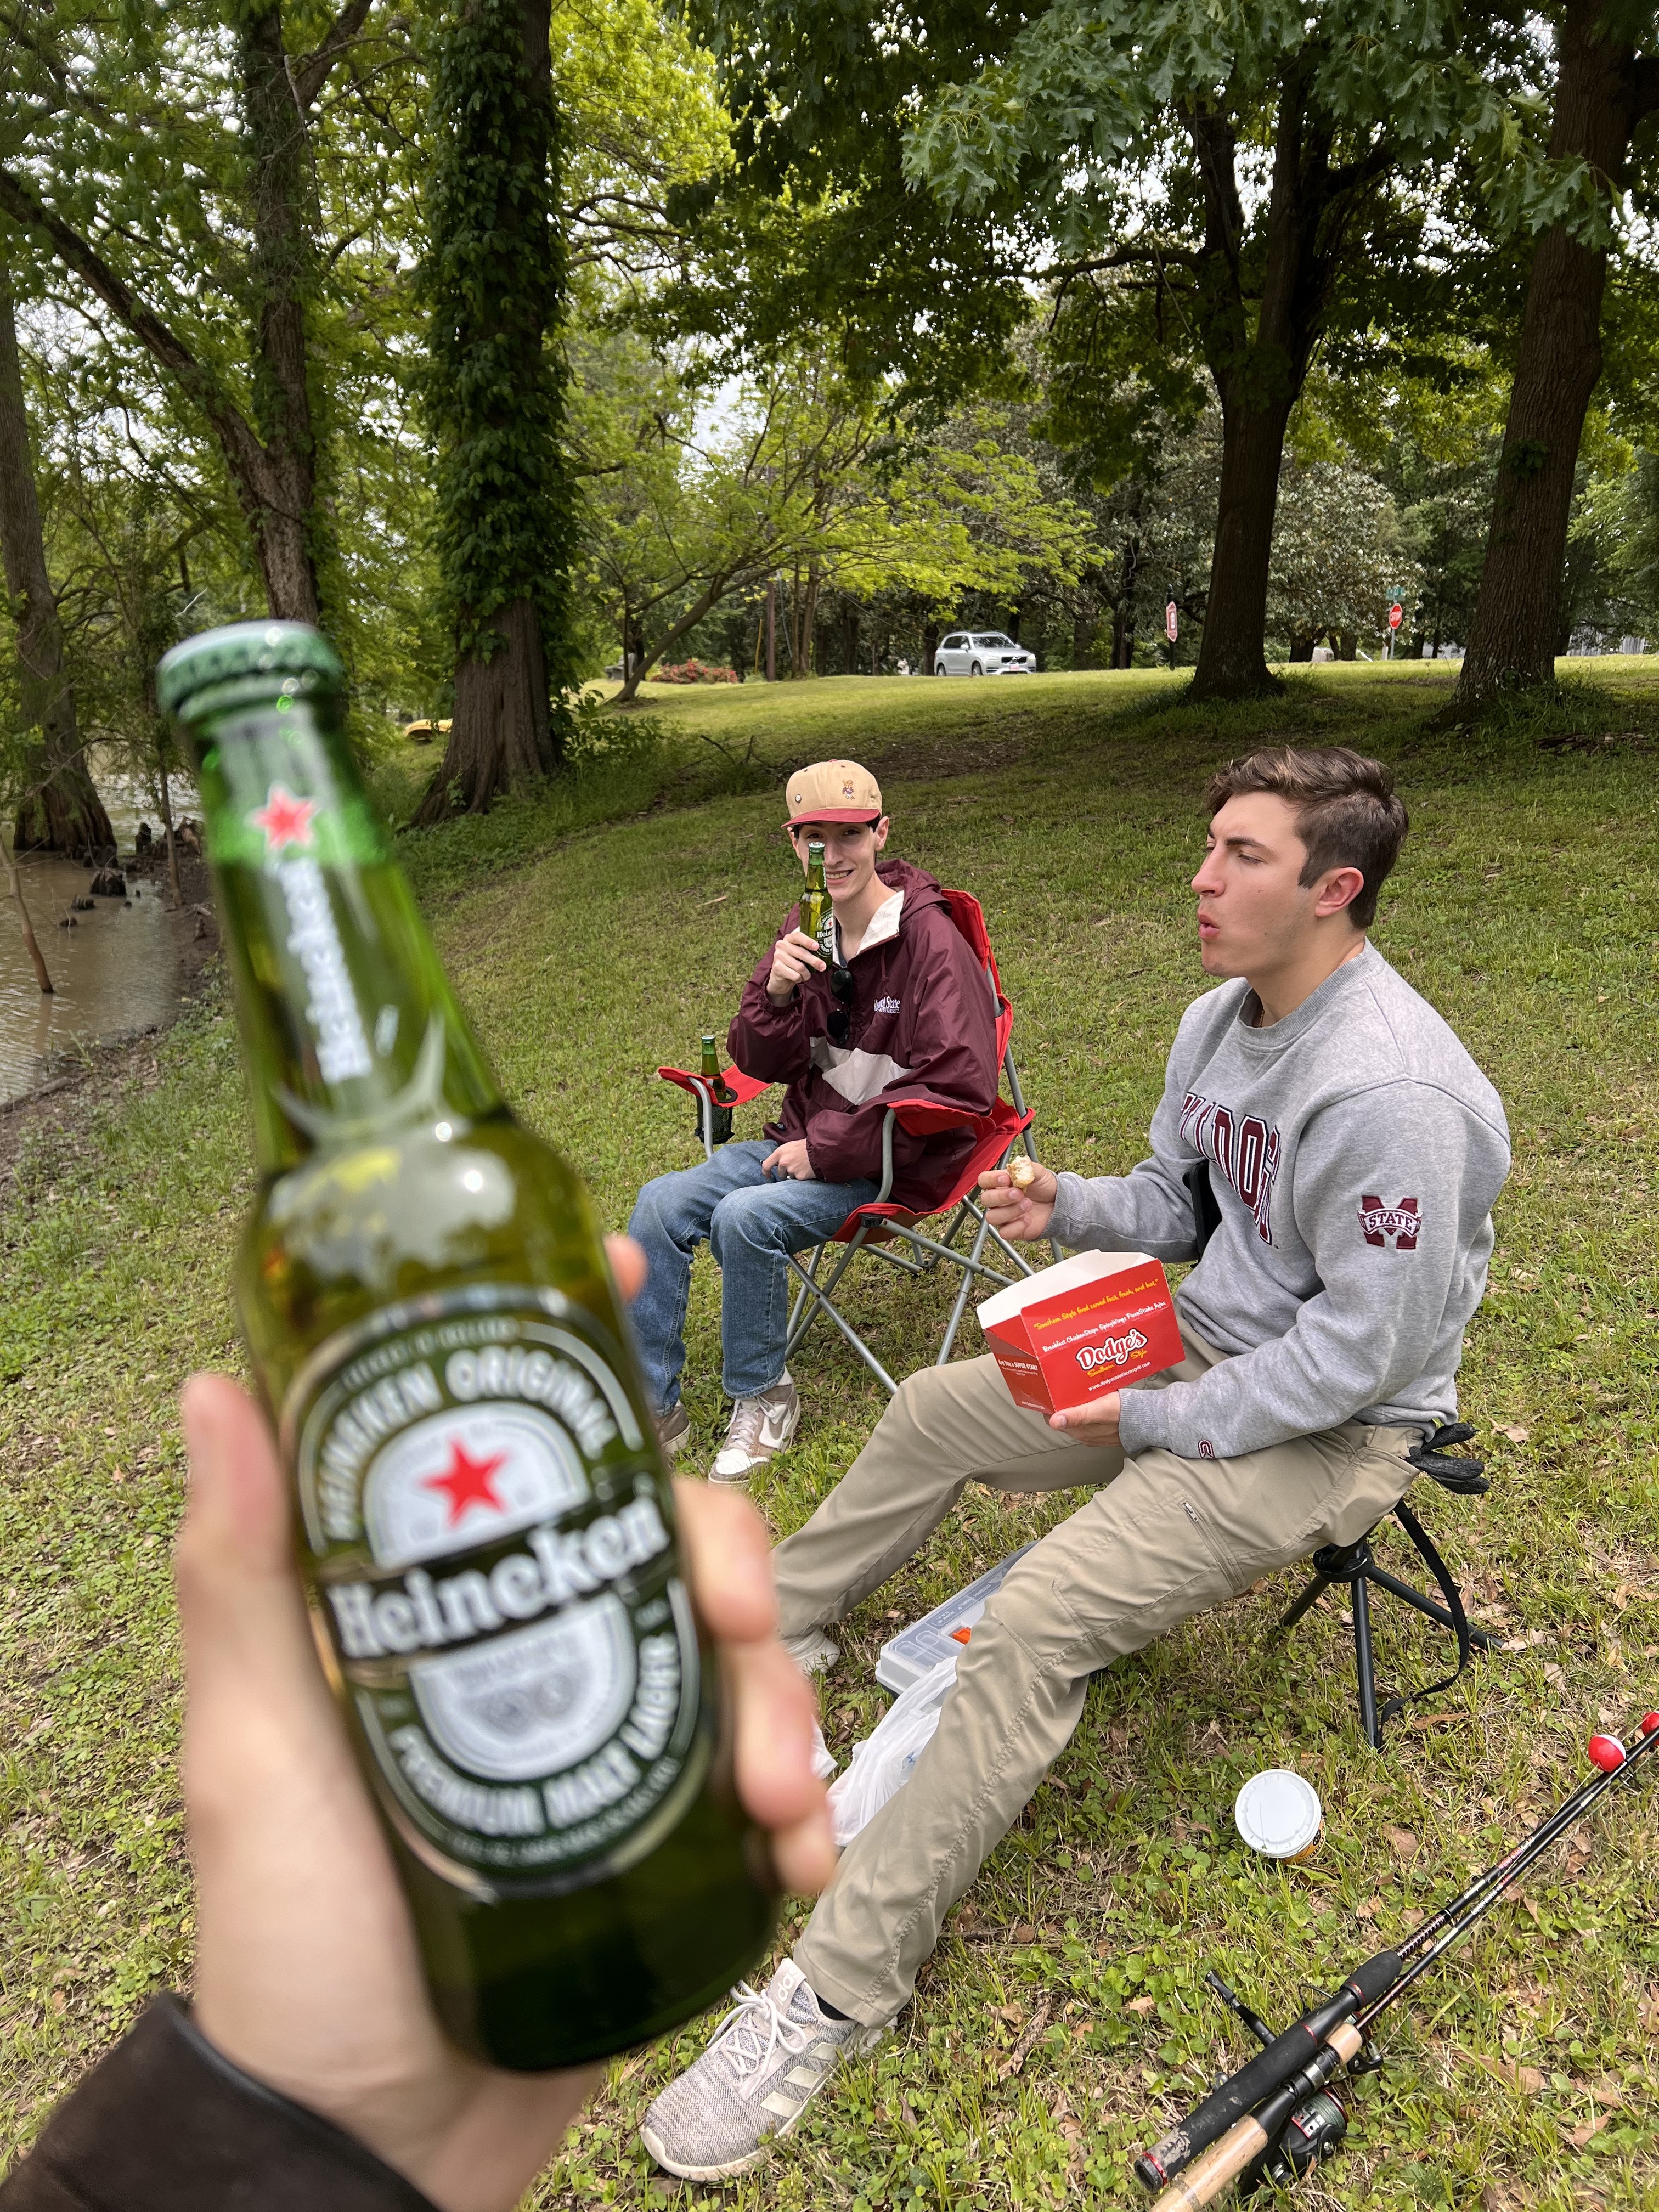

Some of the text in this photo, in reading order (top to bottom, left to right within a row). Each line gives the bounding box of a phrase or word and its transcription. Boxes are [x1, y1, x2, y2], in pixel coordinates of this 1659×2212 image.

[1369, 1212, 1413, 1231] STATE
[1062, 1311, 1077, 1321] Style
[1135, 1283, 1146, 1293] and
[1042, 1339, 1066, 1352] Breakfast
[1076, 1328, 1148, 1370] Dodge's
[1087, 1348, 1148, 1378] Southern Style
[445, 1345, 618, 1460] ORIGINAL
[326, 1496, 670, 1659] Heineken
[543, 1739, 642, 1830] MALT
